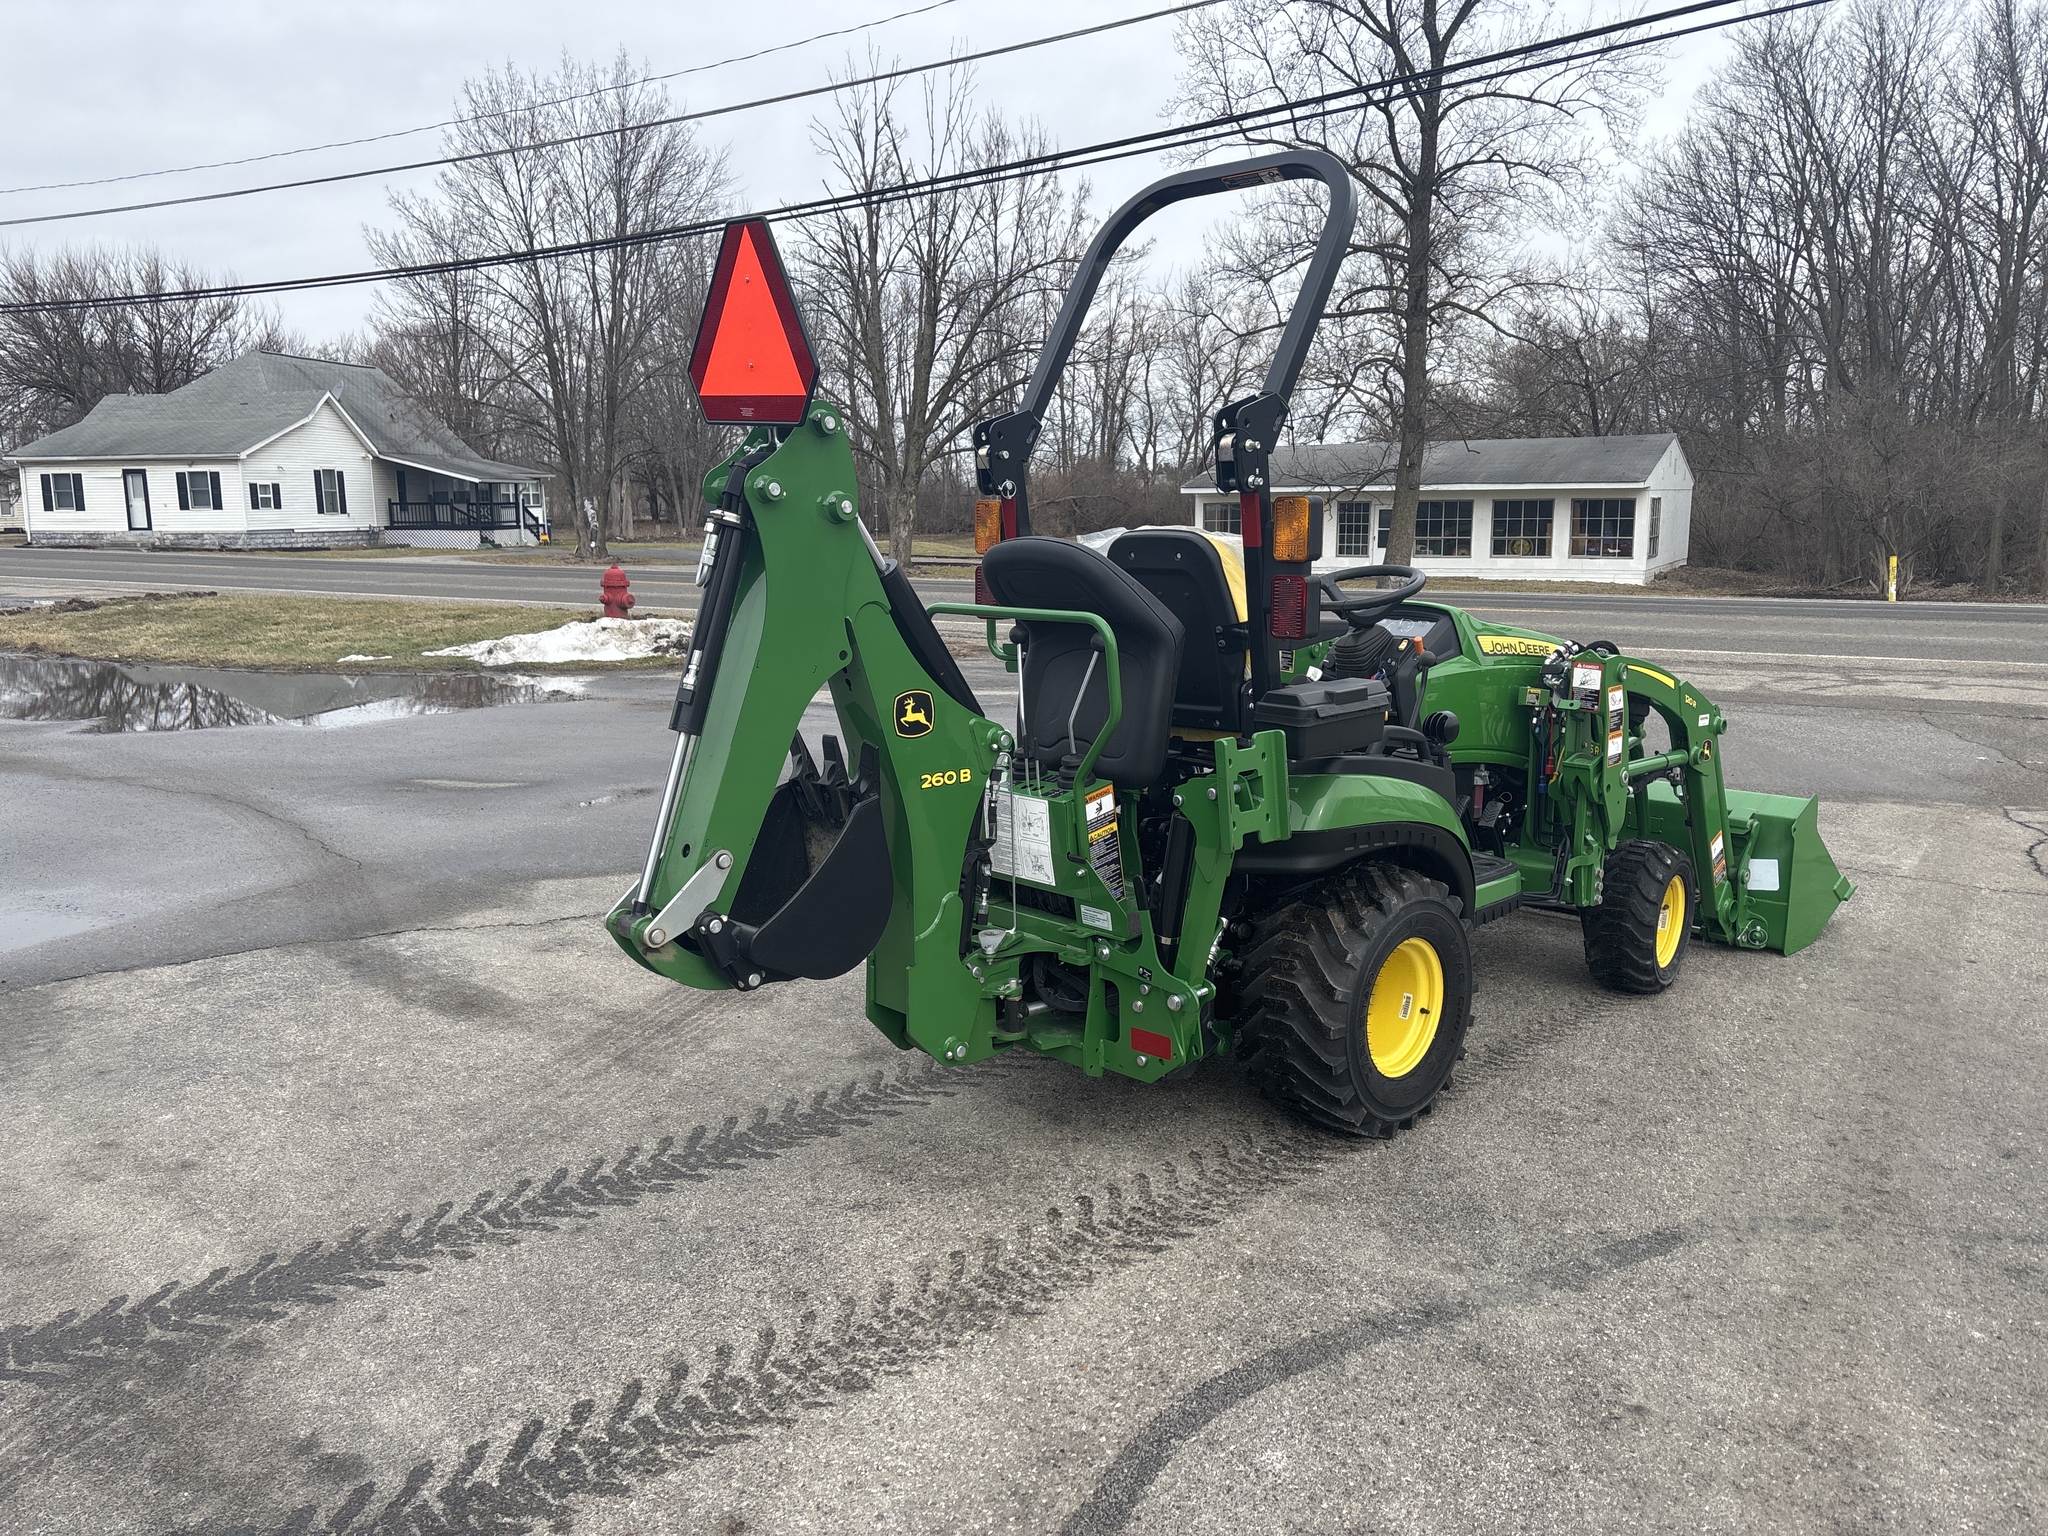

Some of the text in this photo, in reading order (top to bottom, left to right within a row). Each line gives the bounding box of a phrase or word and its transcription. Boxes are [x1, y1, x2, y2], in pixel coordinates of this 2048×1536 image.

[1489, 640, 1551, 655] JOHN DEERE
[920, 768, 972, 789] 260 B
[1093, 826, 1114, 839] CAUTION
